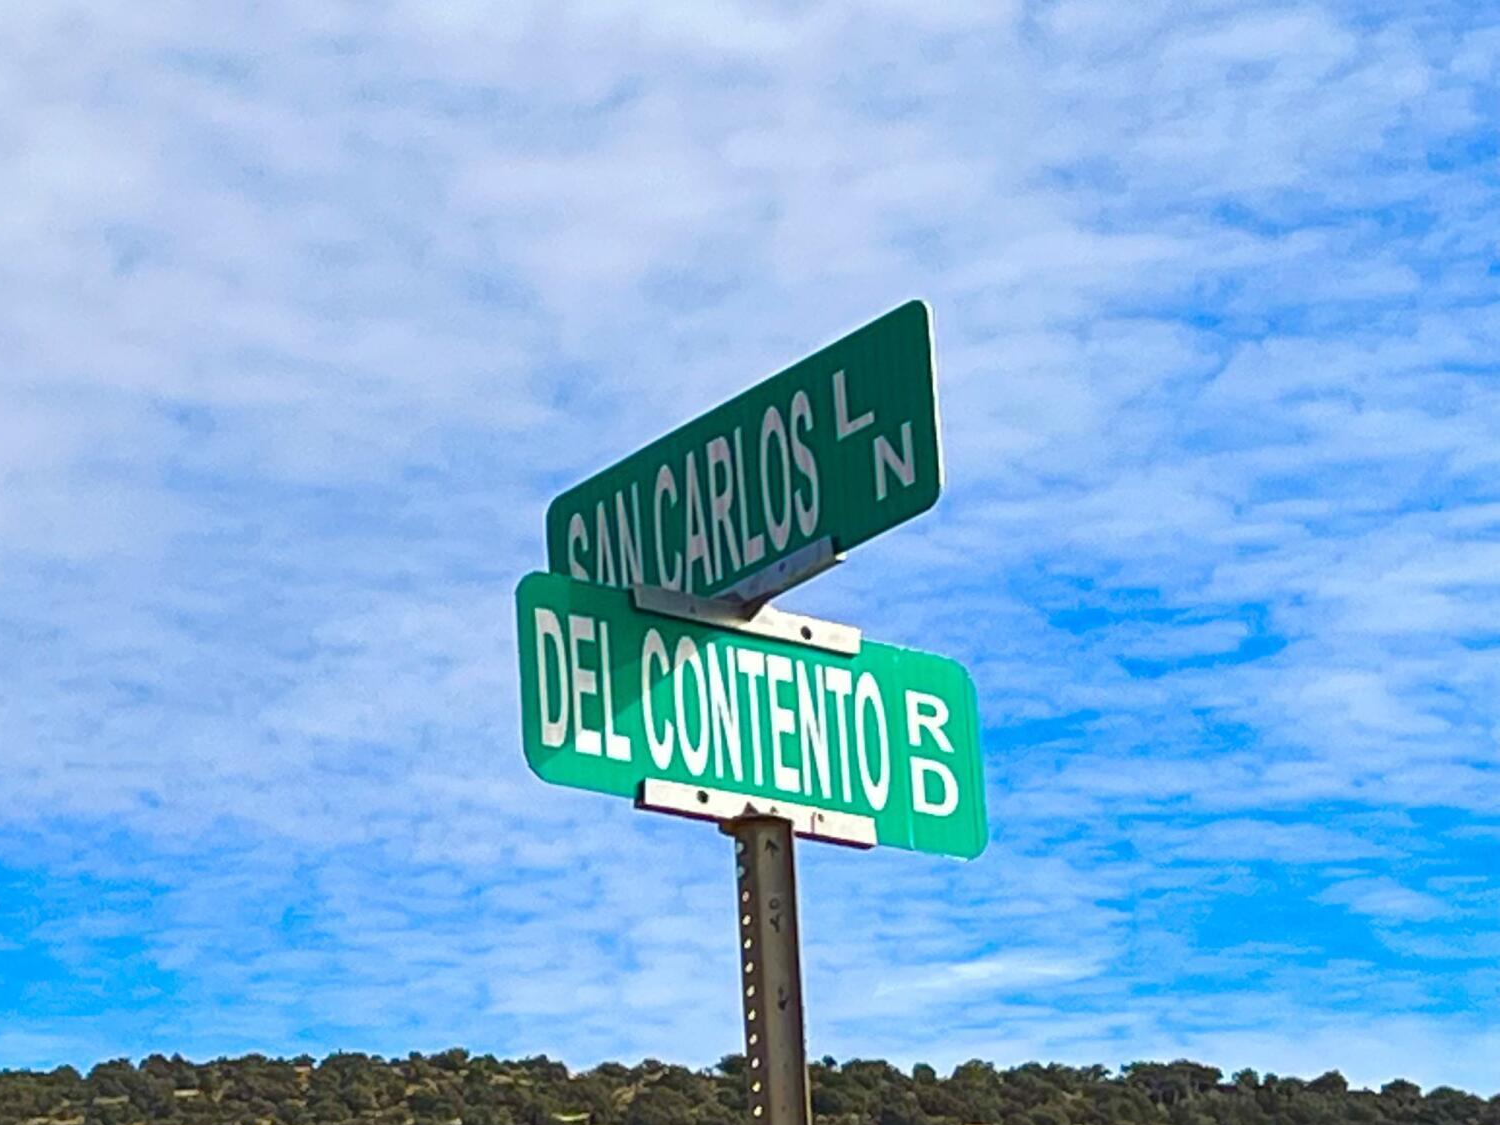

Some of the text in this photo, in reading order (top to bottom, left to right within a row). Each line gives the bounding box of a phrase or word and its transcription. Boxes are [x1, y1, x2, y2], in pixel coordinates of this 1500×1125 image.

[568, 370, 916, 594] SAN CARLOS LN
[534, 608, 959, 816] DEL CONTENTO RD
